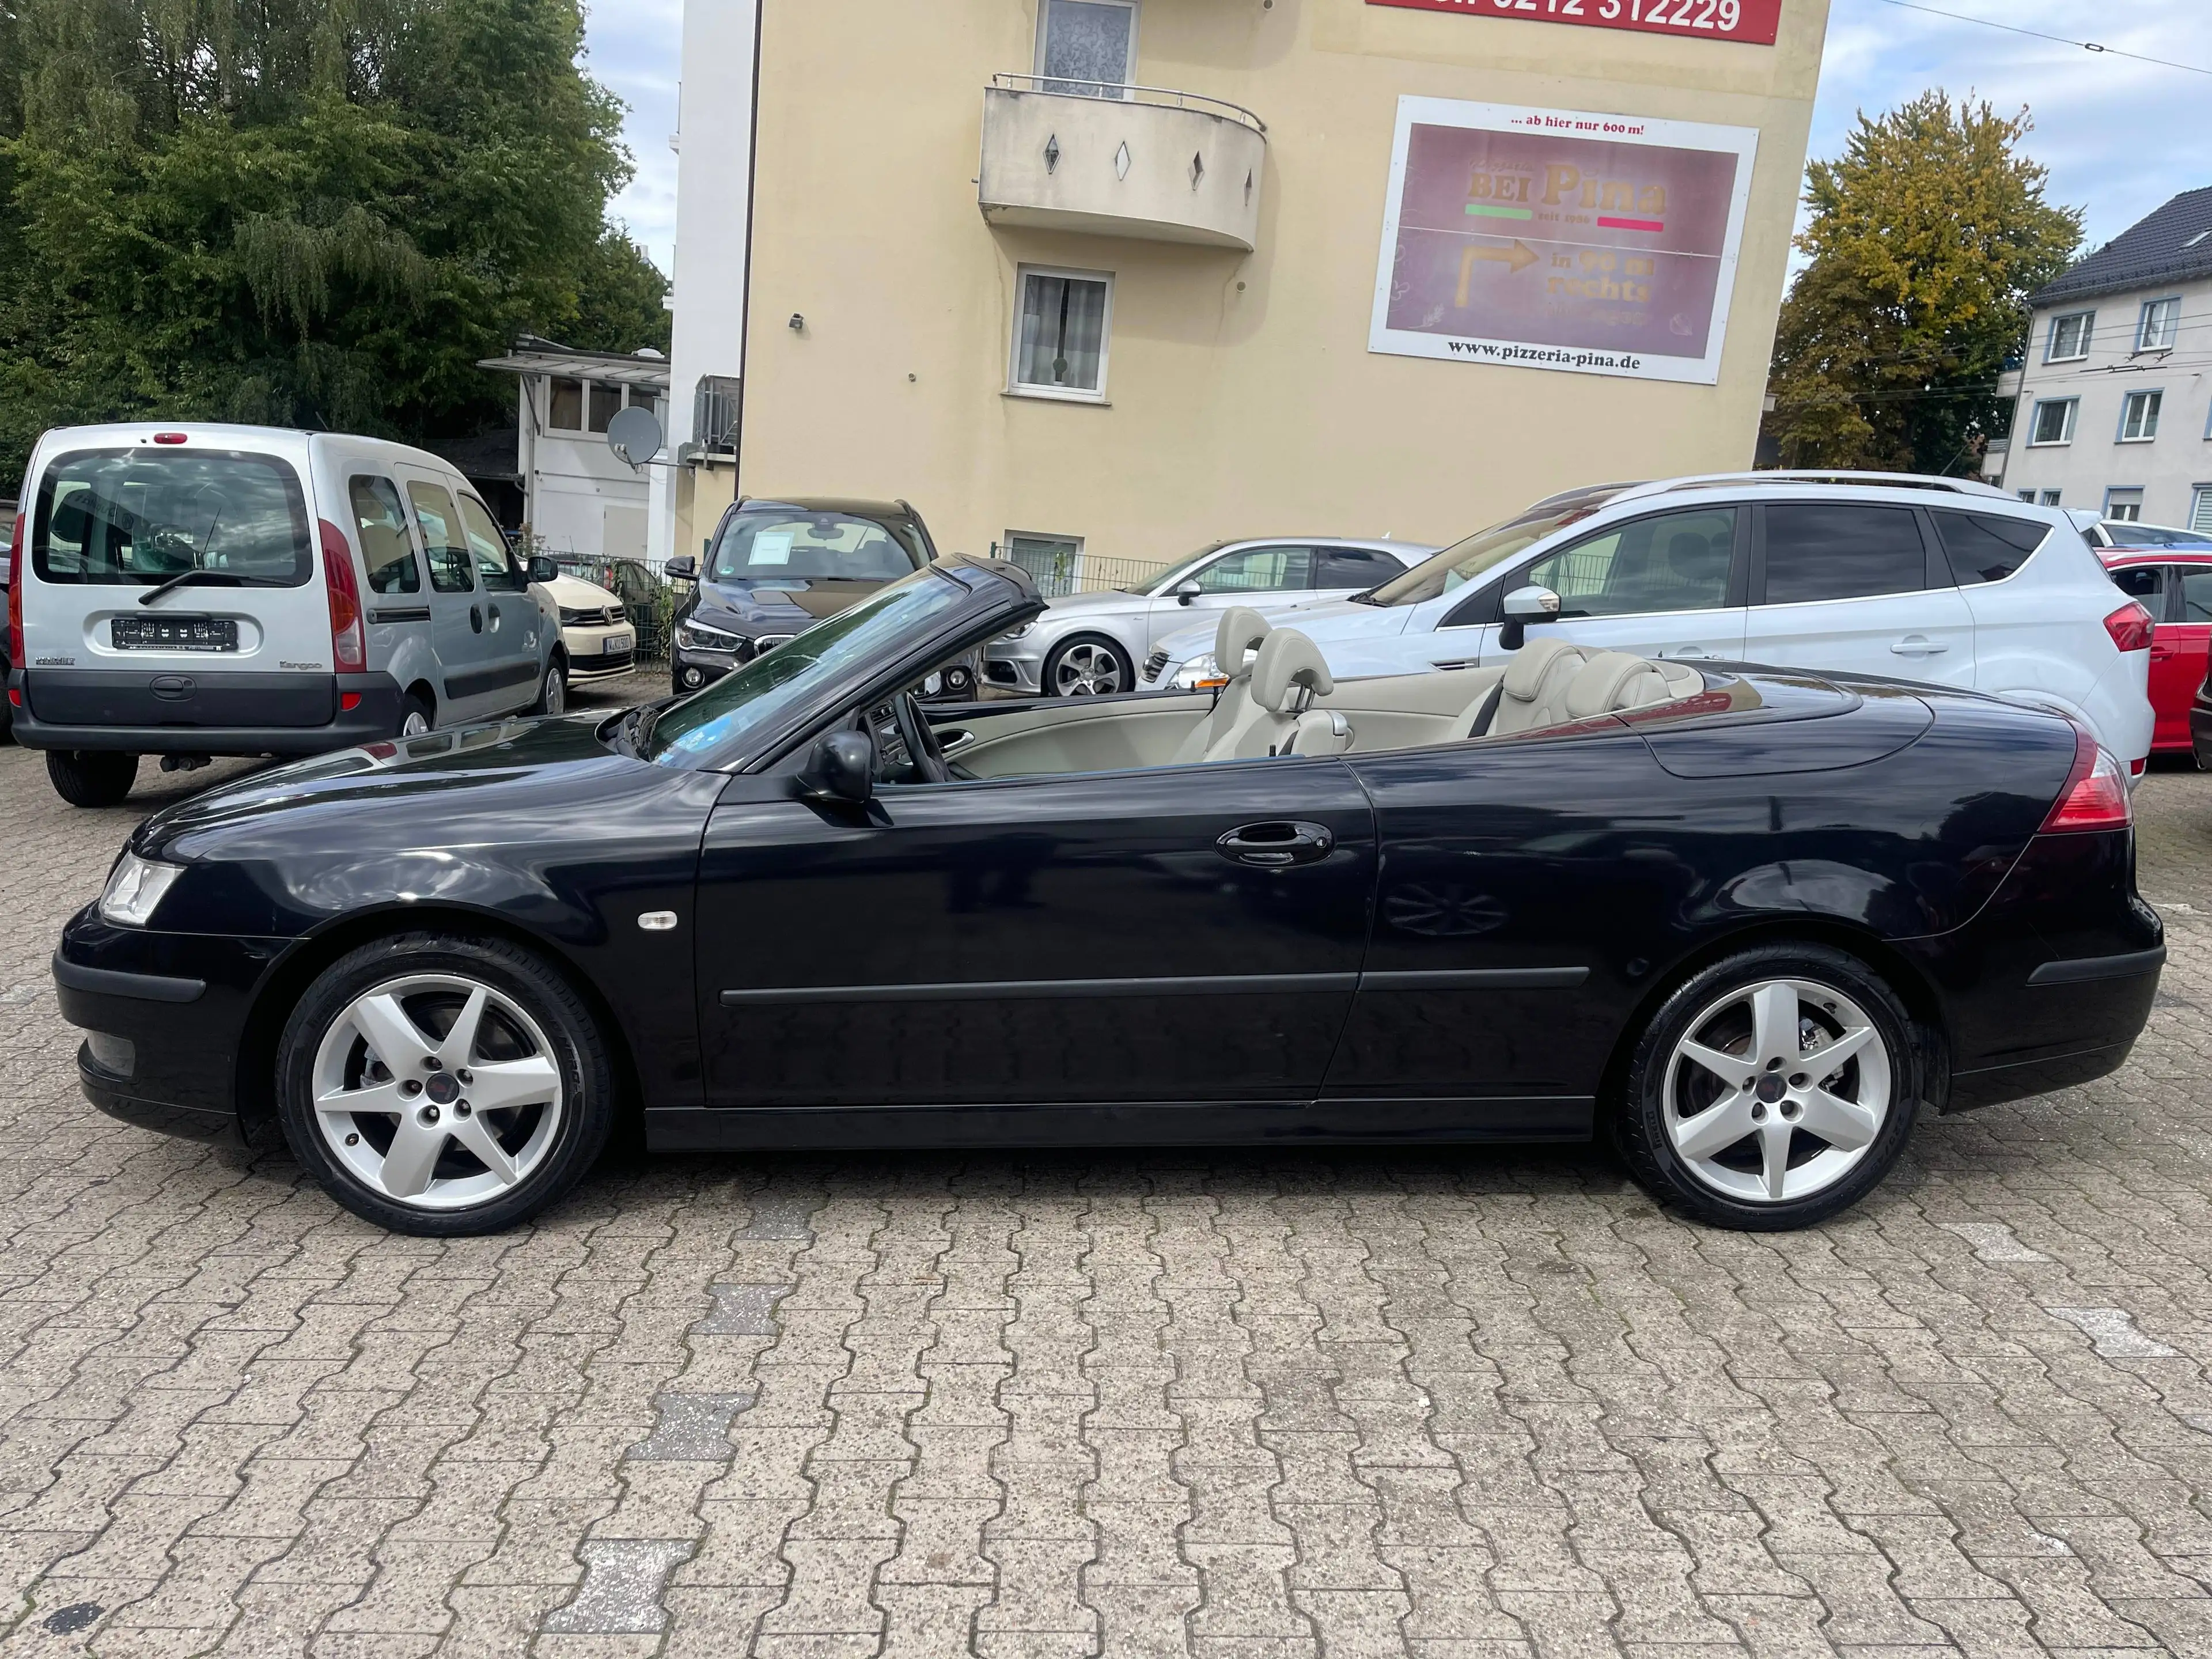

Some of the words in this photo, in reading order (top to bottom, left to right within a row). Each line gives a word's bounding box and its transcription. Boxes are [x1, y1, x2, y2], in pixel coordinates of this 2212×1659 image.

[1526, 115, 1541, 126] ab
[1545, 116, 1572, 128] hier
[1575, 122, 1599, 131] nur
[1603, 122, 1624, 133] 600
[1628, 125, 1644, 135] m!
[1468, 173, 1532, 202] BEI
[1541, 164, 1667, 215] Pina
[1551, 252, 1571, 268] in
[1546, 274, 1652, 303] rechts
[1448, 342, 1641, 369] www.pizzeria-pina.de
[279, 660, 323, 671] Kangoo
